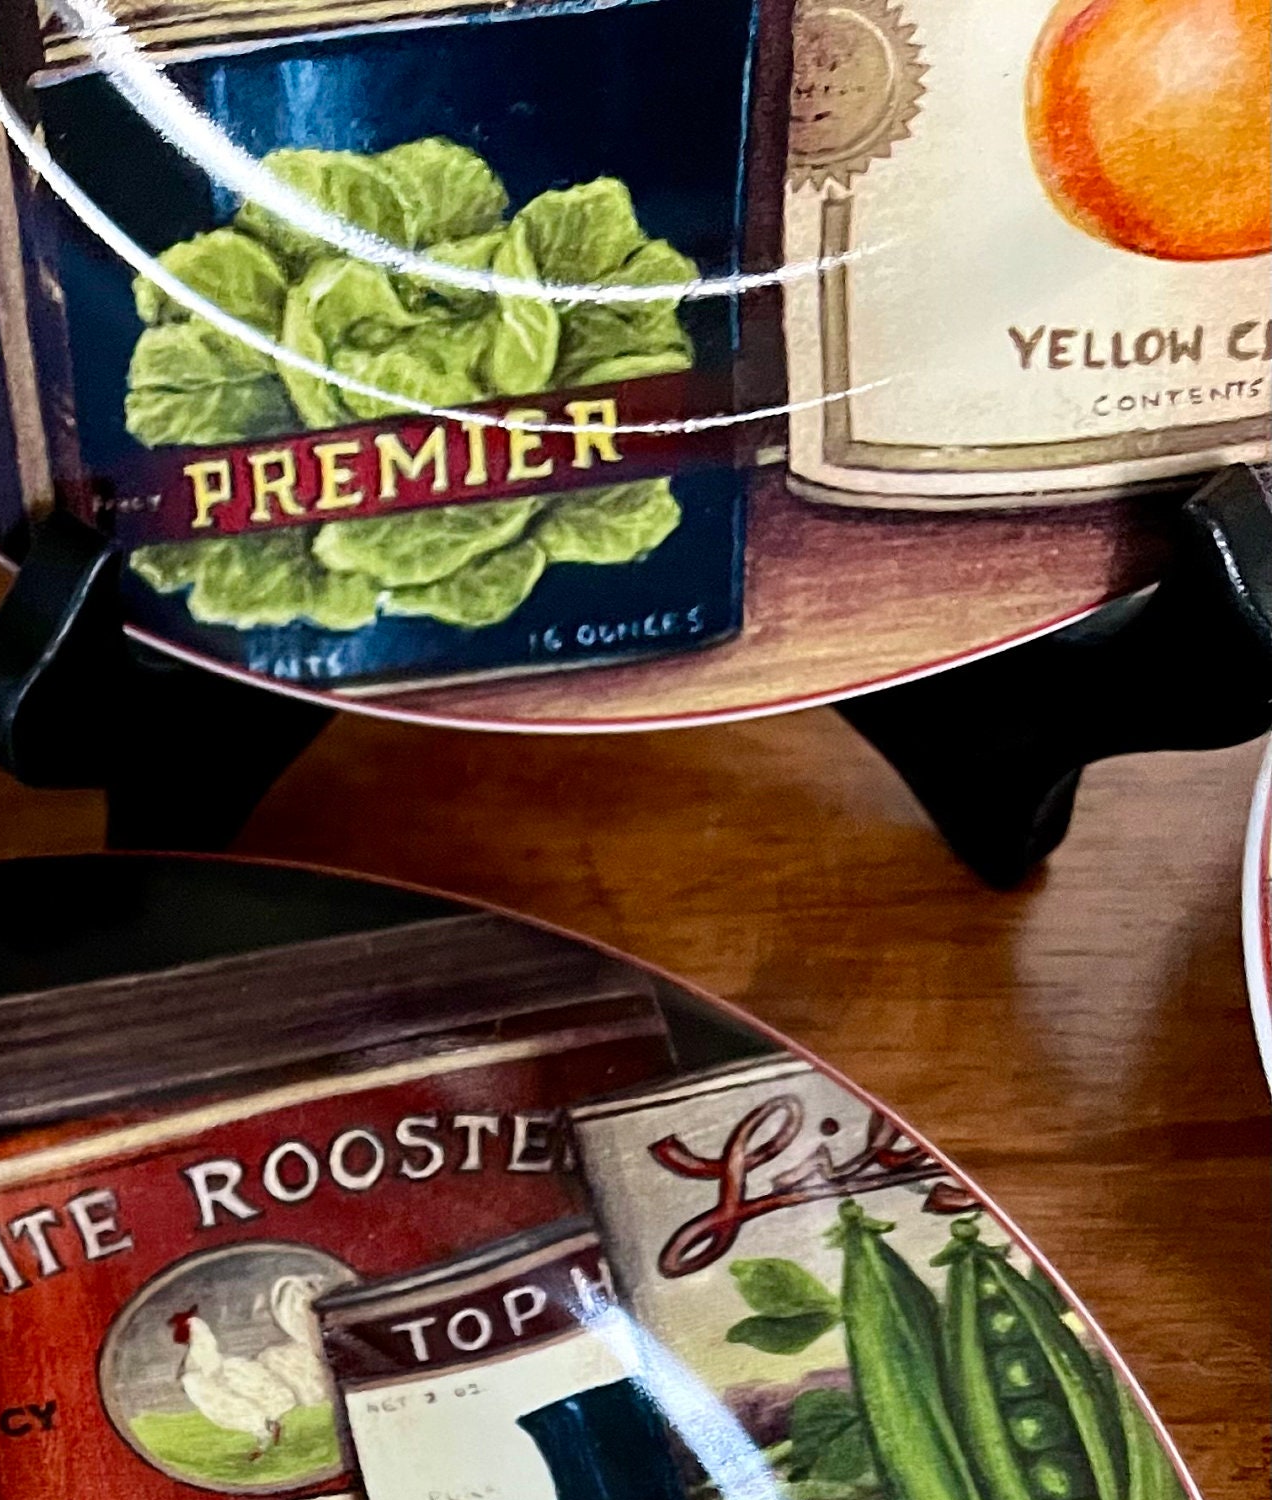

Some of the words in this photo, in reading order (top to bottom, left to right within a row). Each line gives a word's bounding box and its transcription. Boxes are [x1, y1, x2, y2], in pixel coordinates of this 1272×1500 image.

[1007, 323, 1204, 370] YELLOW
[1091, 376, 1265, 417] CONTENTS
[183, 397, 624, 530] PREMIER
[389, 1284, 548, 1362] TOP
